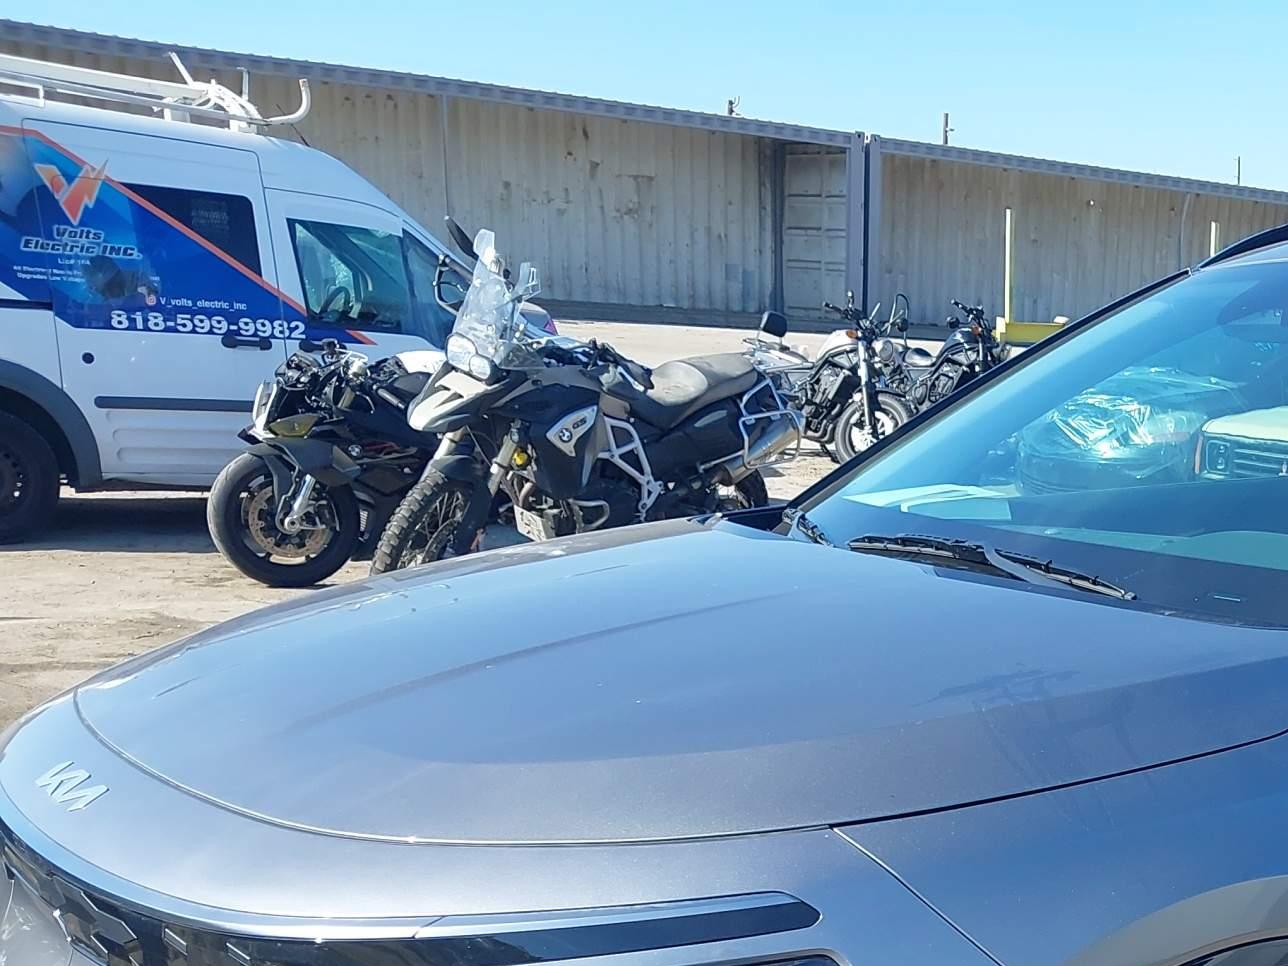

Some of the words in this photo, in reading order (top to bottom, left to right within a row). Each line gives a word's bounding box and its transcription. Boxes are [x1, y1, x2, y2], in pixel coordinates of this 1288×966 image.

[54, 225, 103, 241] Volts
[21, 237, 98, 255] Electric
[101, 244, 143, 259] INC.
[111, 310, 306, 340] 818-599-9982
